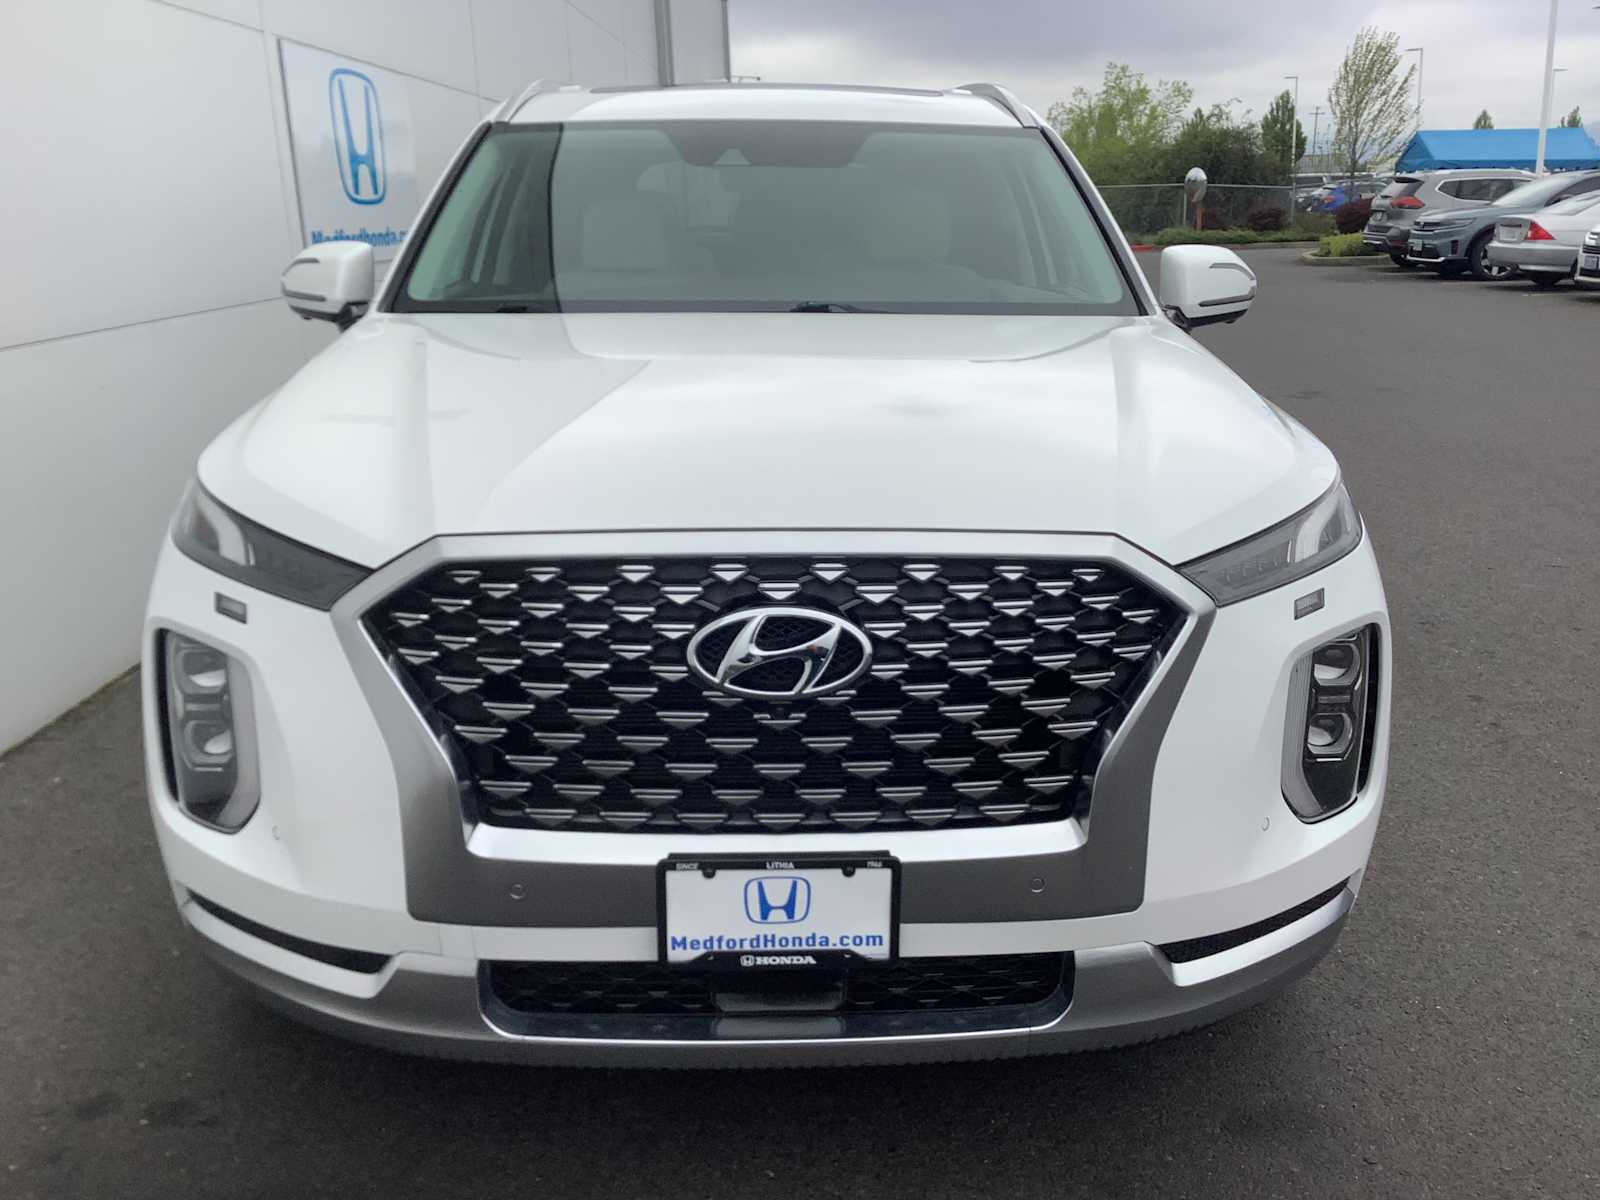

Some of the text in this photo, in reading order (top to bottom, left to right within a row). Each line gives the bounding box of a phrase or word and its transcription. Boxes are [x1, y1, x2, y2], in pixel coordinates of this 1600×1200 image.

[766, 861, 795, 870] LITHIA
[671, 932, 884, 951] MedfordHonda.com
[755, 955, 817, 965] HONDA
